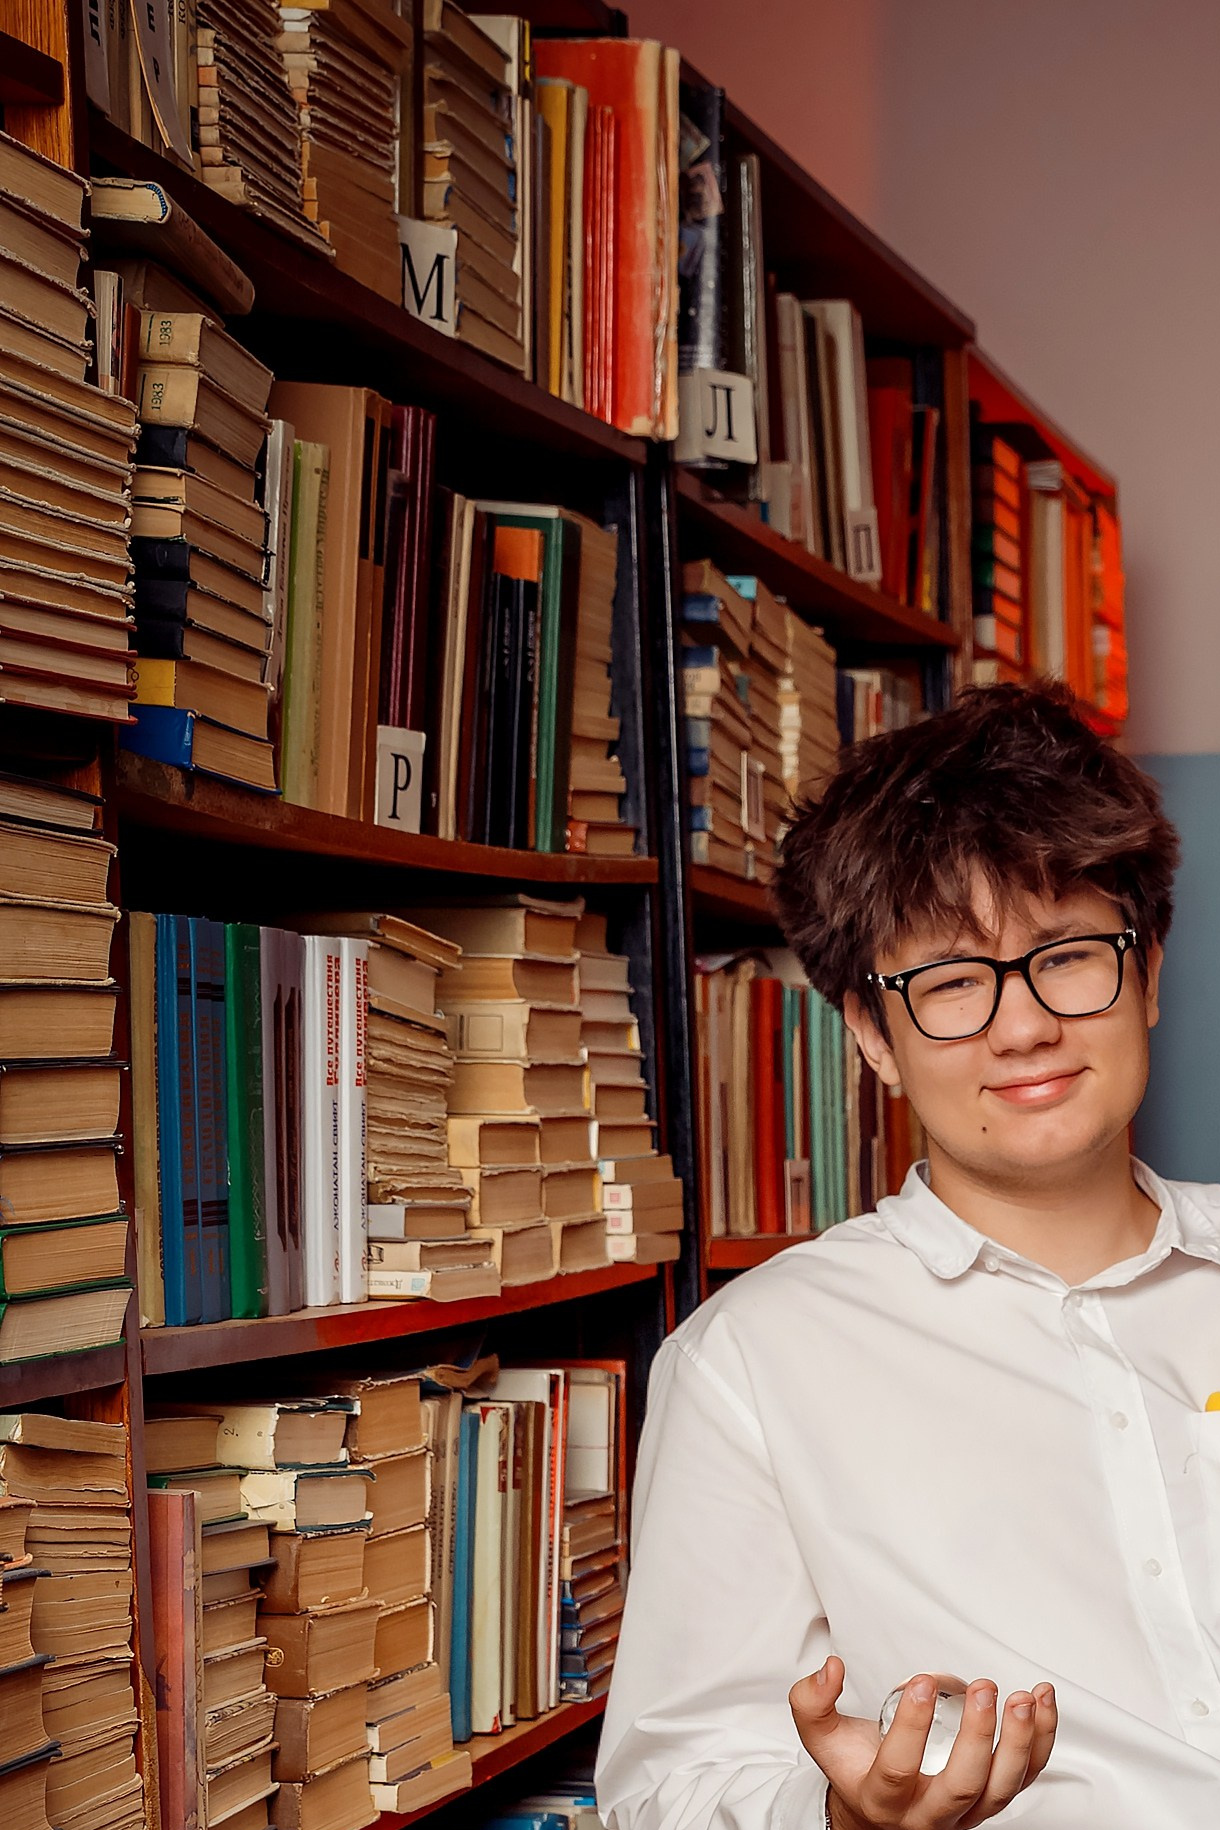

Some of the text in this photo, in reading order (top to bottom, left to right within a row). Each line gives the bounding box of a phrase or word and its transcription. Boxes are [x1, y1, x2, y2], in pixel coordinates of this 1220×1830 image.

[400, 244, 449, 322] М
[159, 320, 172, 346] 1983
[152, 383, 164, 410] 1983
[705, 383, 738, 441] Л
[388, 753, 411, 820] Р
[325, 954, 335, 1056] путешествия
[354, 957, 363, 1057] путешествия
[331, 1099, 339, 1147] СВИФТ
